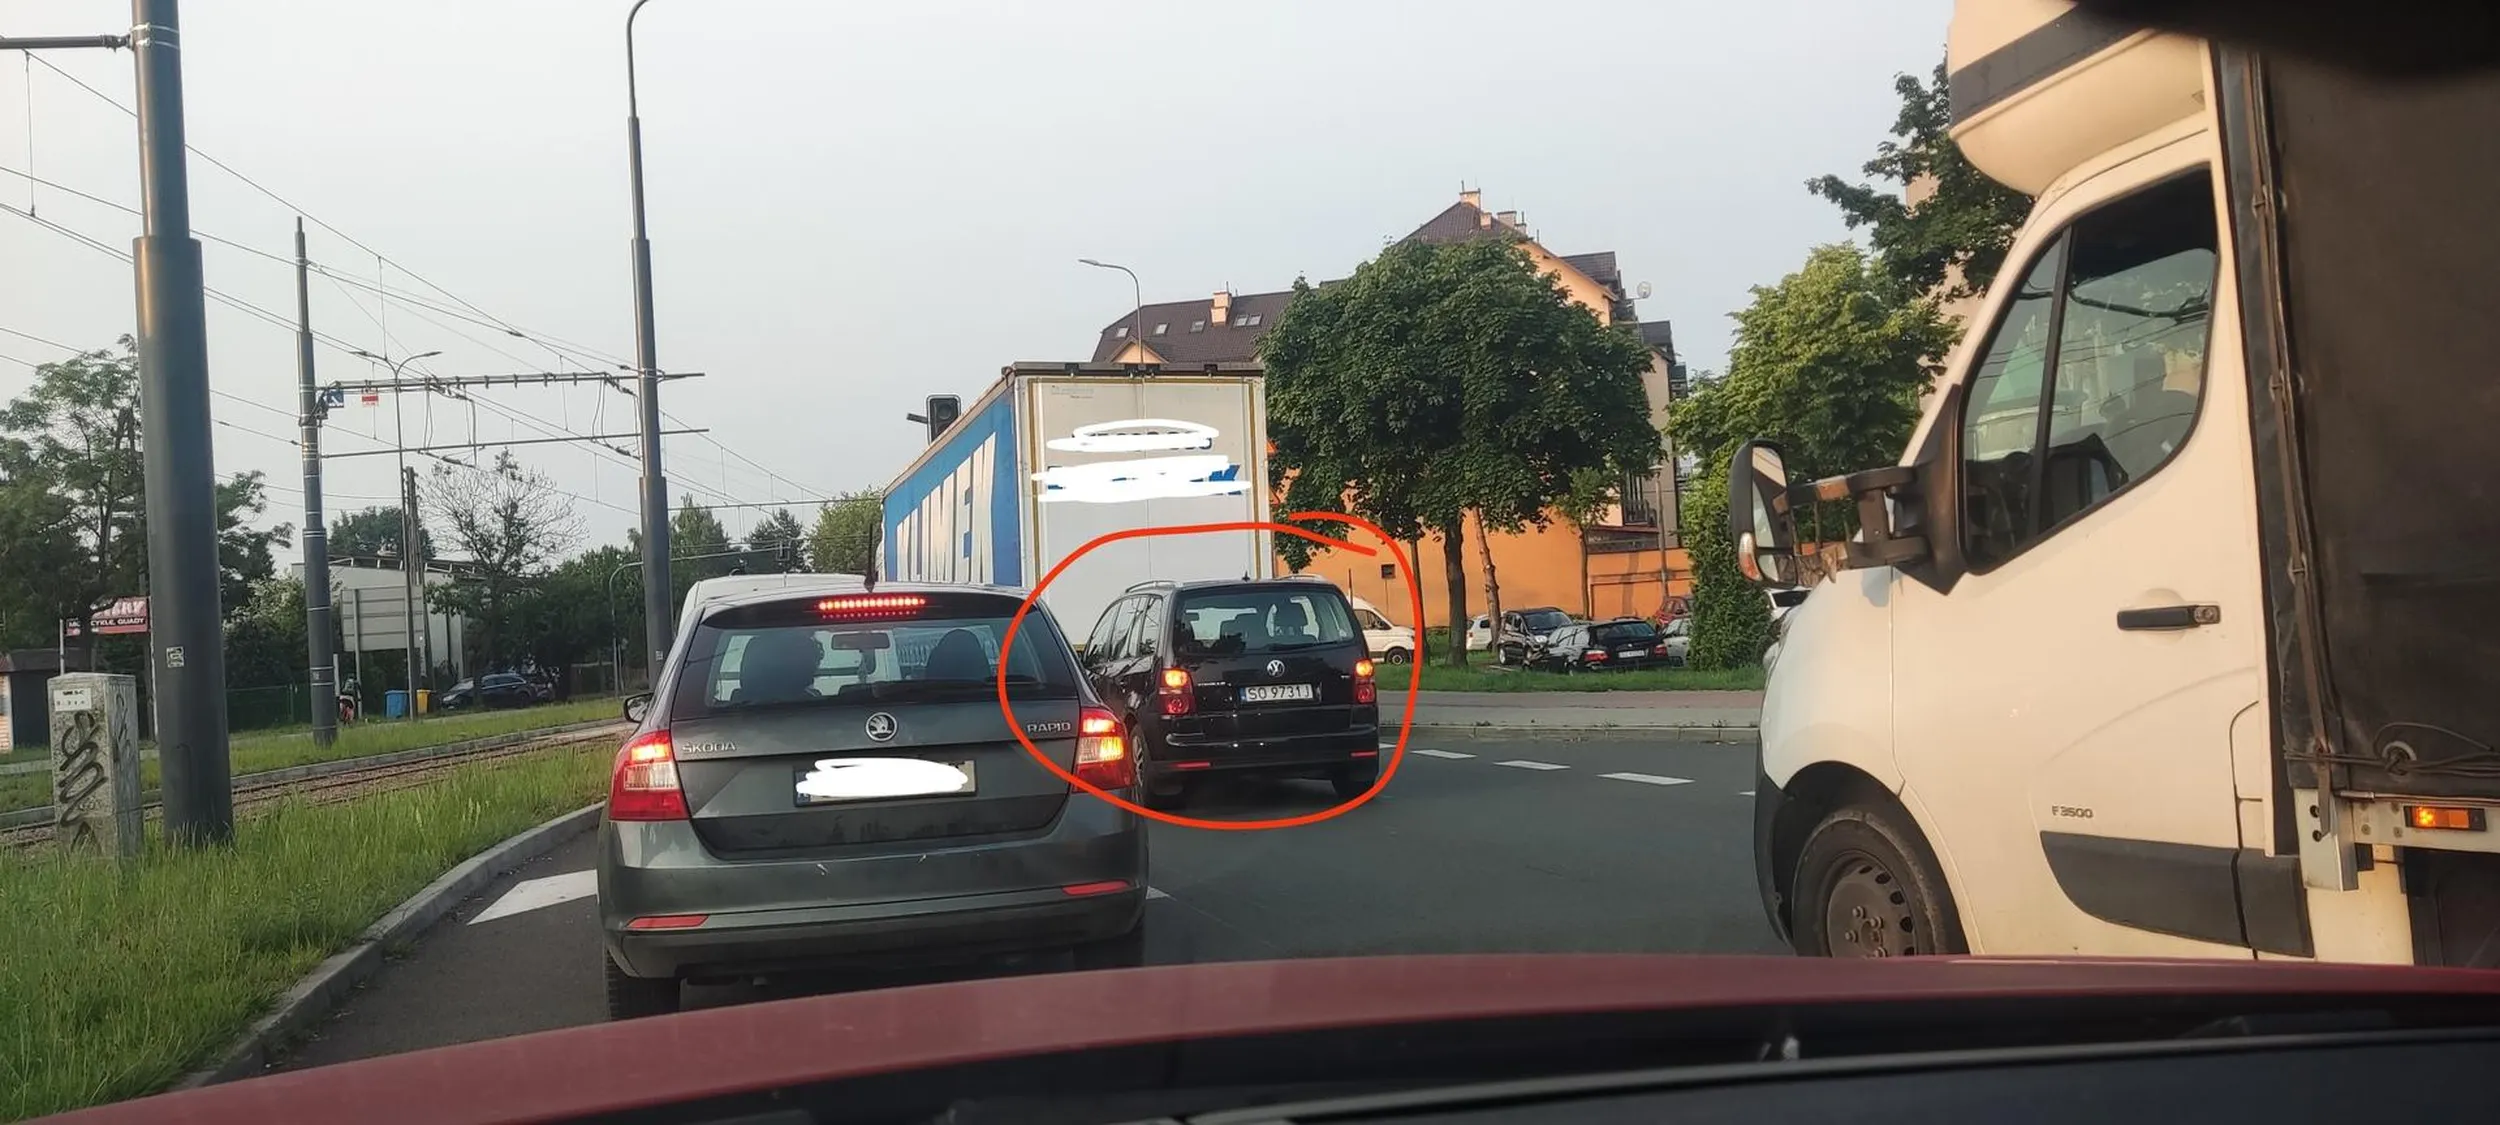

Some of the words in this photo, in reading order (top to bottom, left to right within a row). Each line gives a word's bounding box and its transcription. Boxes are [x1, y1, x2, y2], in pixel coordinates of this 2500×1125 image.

[896, 432, 996, 582] KLIMEX
[1248, 687, 1268, 700] SO
[1271, 685, 1310, 699] 9731J
[1027, 722, 1071, 733] RAPID
